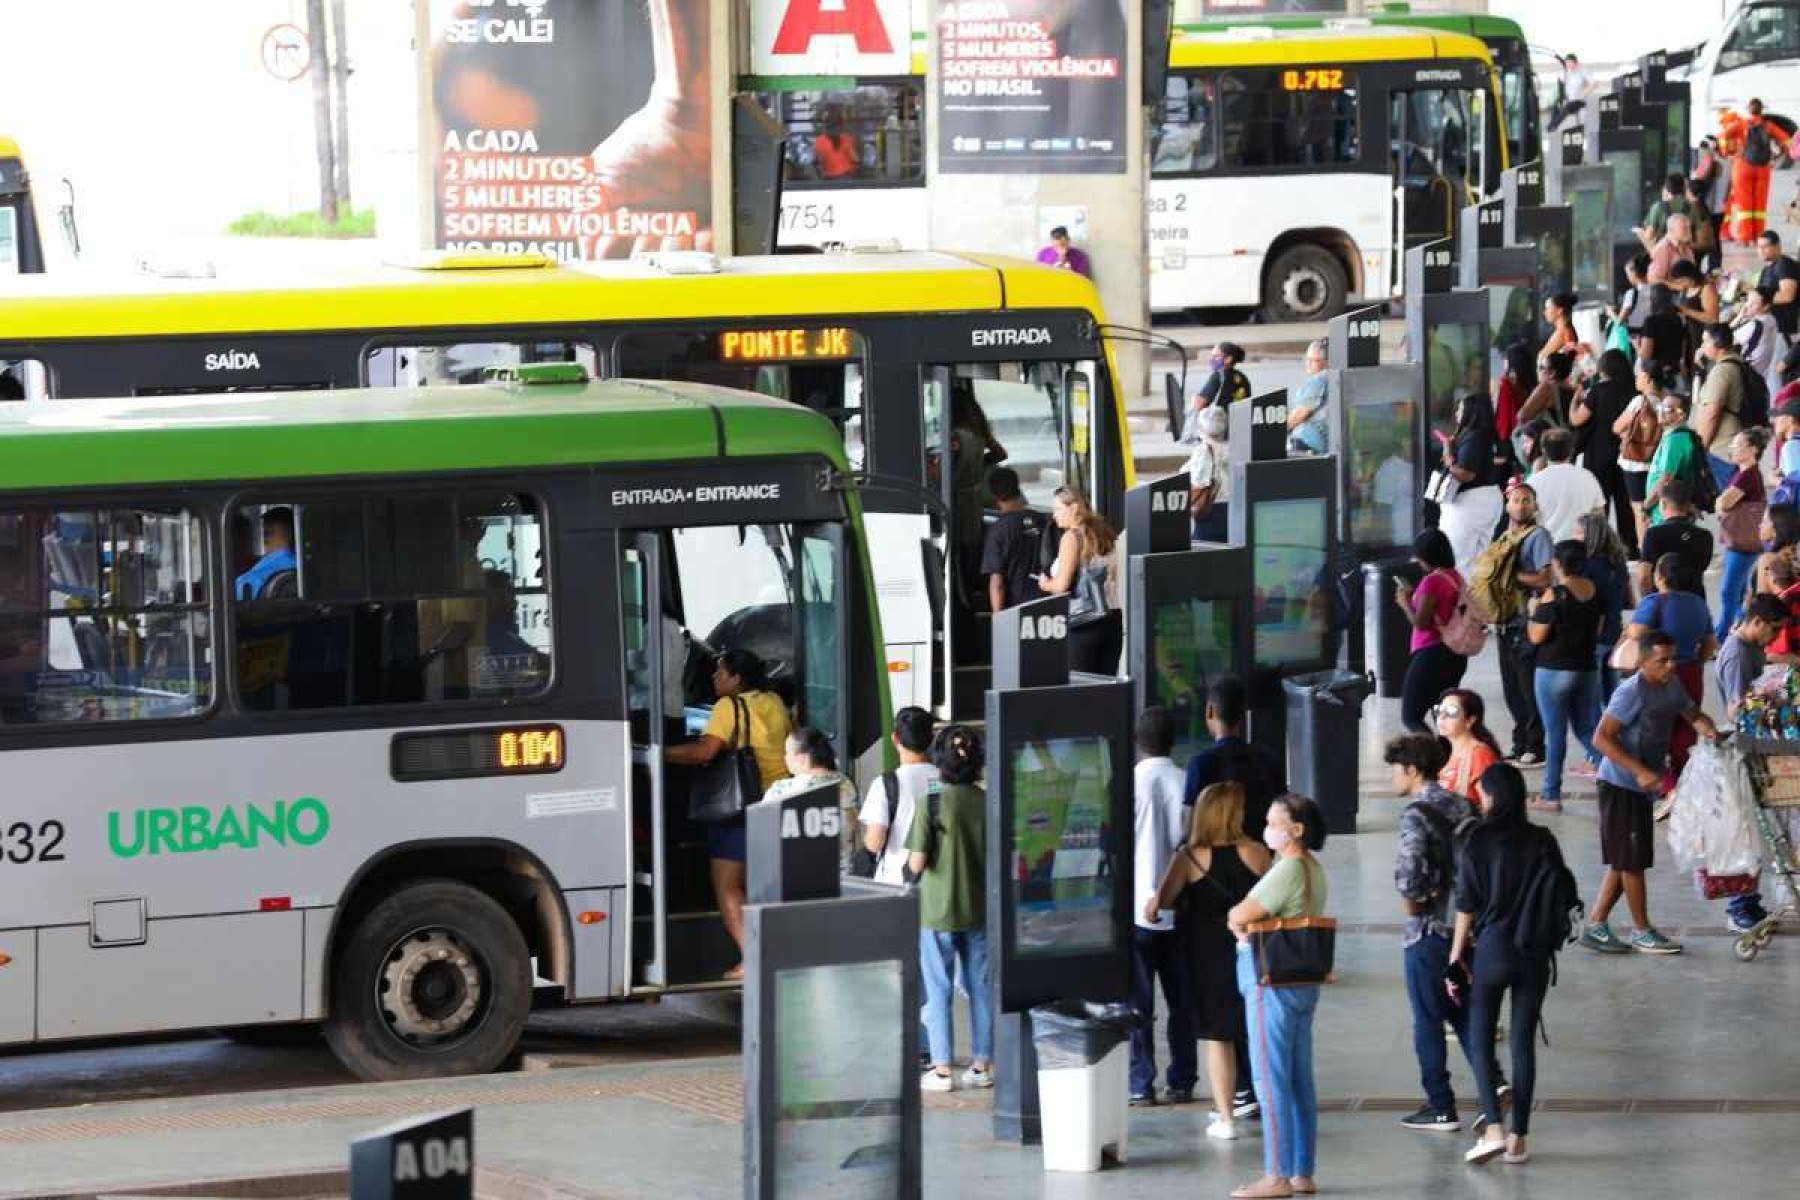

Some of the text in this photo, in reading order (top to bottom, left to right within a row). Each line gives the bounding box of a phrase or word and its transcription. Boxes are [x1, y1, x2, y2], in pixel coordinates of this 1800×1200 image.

[446, 19, 480, 42] SE
[772, 0, 894, 54] A
[958, 41, 1055, 57] MULHERES
[943, 55, 1114, 76] SOFREM VIOLÊNCIA
[944, 79, 1042, 95] NO BRASIL.
[1283, 71, 1343, 90] 0.762
[444, 130, 539, 151] A CADA
[444, 158, 595, 185] 2 MINUTOS,
[444, 185, 601, 208] 5 MULHERES
[1175, 193, 1187, 211] 2
[444, 207, 692, 235] SOFREM VIOLÊNCIA
[1425, 251, 1450, 266] A 10
[971, 328, 1052, 347] ENTRADA
[1350, 320, 1379, 337] A 09
[725, 328, 847, 358] PONTE JK
[205, 348, 260, 370] SAÍDA
[1253, 405, 1287, 424] A 08
[1152, 491, 1189, 512] A 07
[1020, 615, 1067, 640] A 06
[500, 731, 558, 767] 0.104
[108, 797, 330, 858] URBANO
[780, 806, 840, 838] A 05
[0, 820, 65, 864] 32
[395, 1137, 470, 1180] A 04
